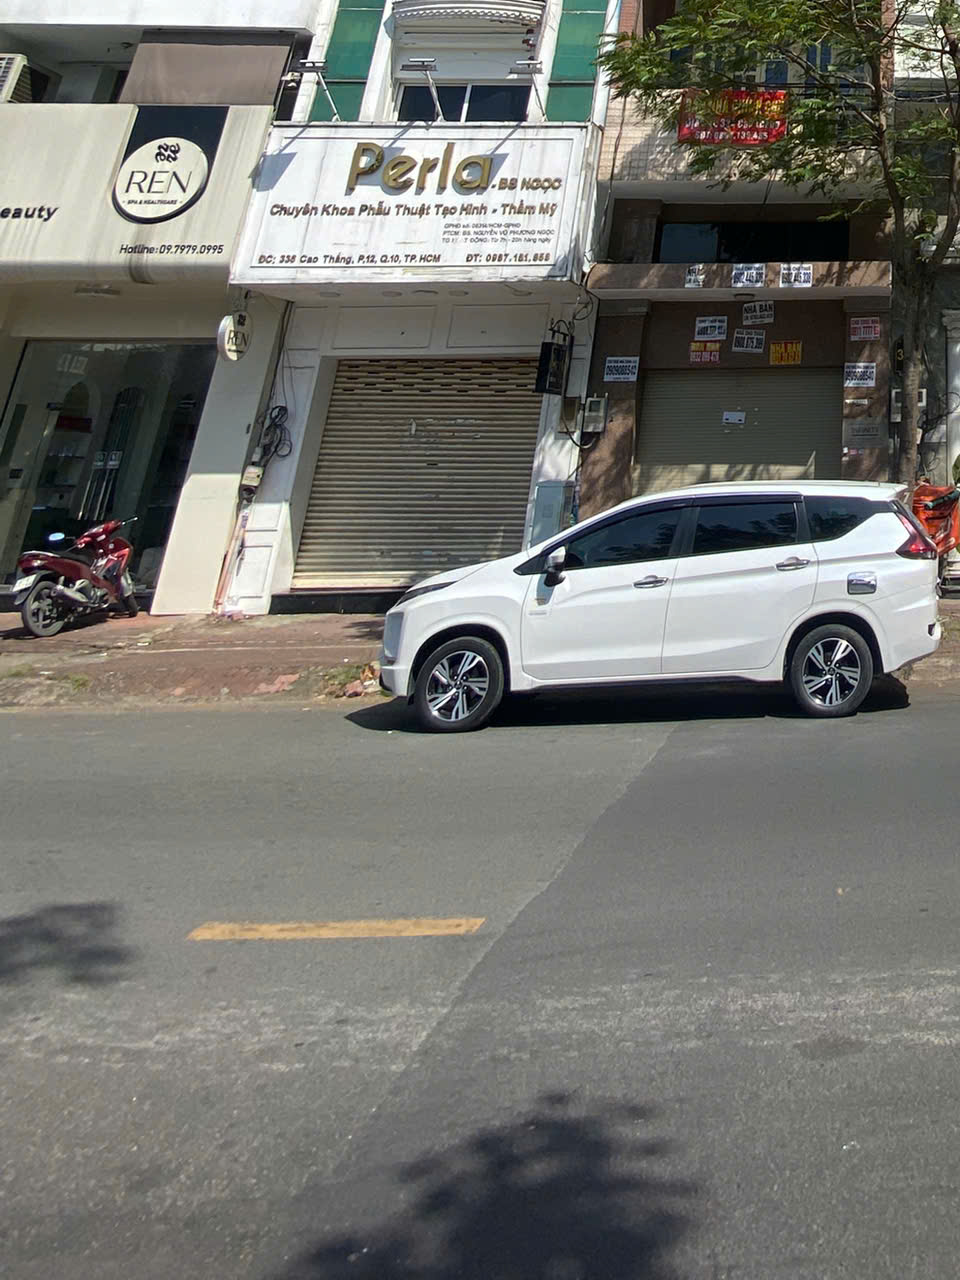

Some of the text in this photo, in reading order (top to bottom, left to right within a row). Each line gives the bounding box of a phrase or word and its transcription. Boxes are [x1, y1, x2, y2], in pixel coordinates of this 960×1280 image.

[347, 142, 494, 192] Perla
[124, 171, 192, 193] REN
[497, 177, 562, 194] BS NGỌC
[0, 205, 59, 222] eauty
[270, 202, 319, 219] Chuyên
[320, 205, 356, 216] Khoa
[358, 200, 391, 216] Phẫu
[394, 204, 431, 219] Thuật
[435, 205, 458, 218] Tạo
[459, 203, 488, 216] Hình
[501, 199, 536, 216] Thẩm
[538, 204, 558, 217] Mỹ
[119, 244, 224, 254] Hotline: 09.7979.0995
[299, 255, 319, 263] Cao
[323, 252, 354, 264] Thắng,
[466, 254, 482, 262] ĐT:
